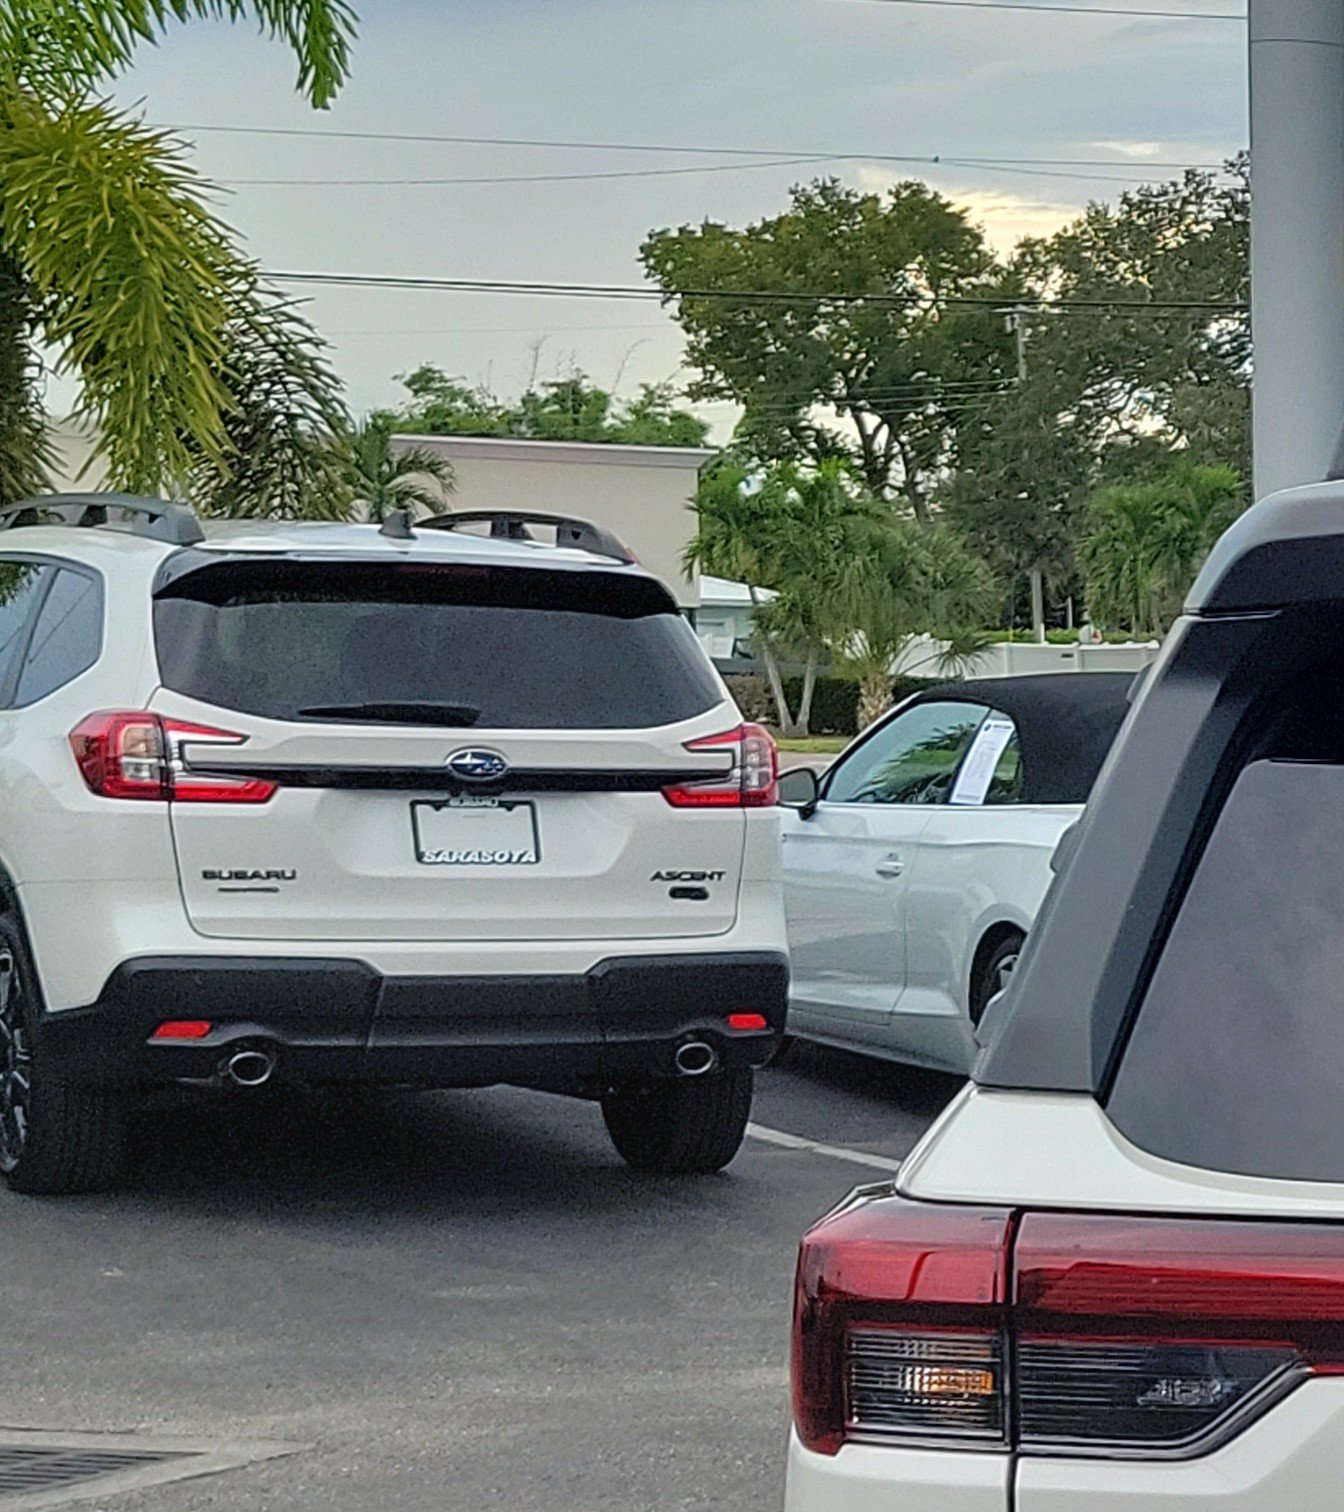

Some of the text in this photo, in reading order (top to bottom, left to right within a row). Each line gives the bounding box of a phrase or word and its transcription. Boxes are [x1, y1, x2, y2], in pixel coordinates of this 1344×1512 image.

[422, 849, 537, 863] SARASOTA
[201, 868, 297, 881] SUBARU
[649, 870, 727, 882] ASCENT
